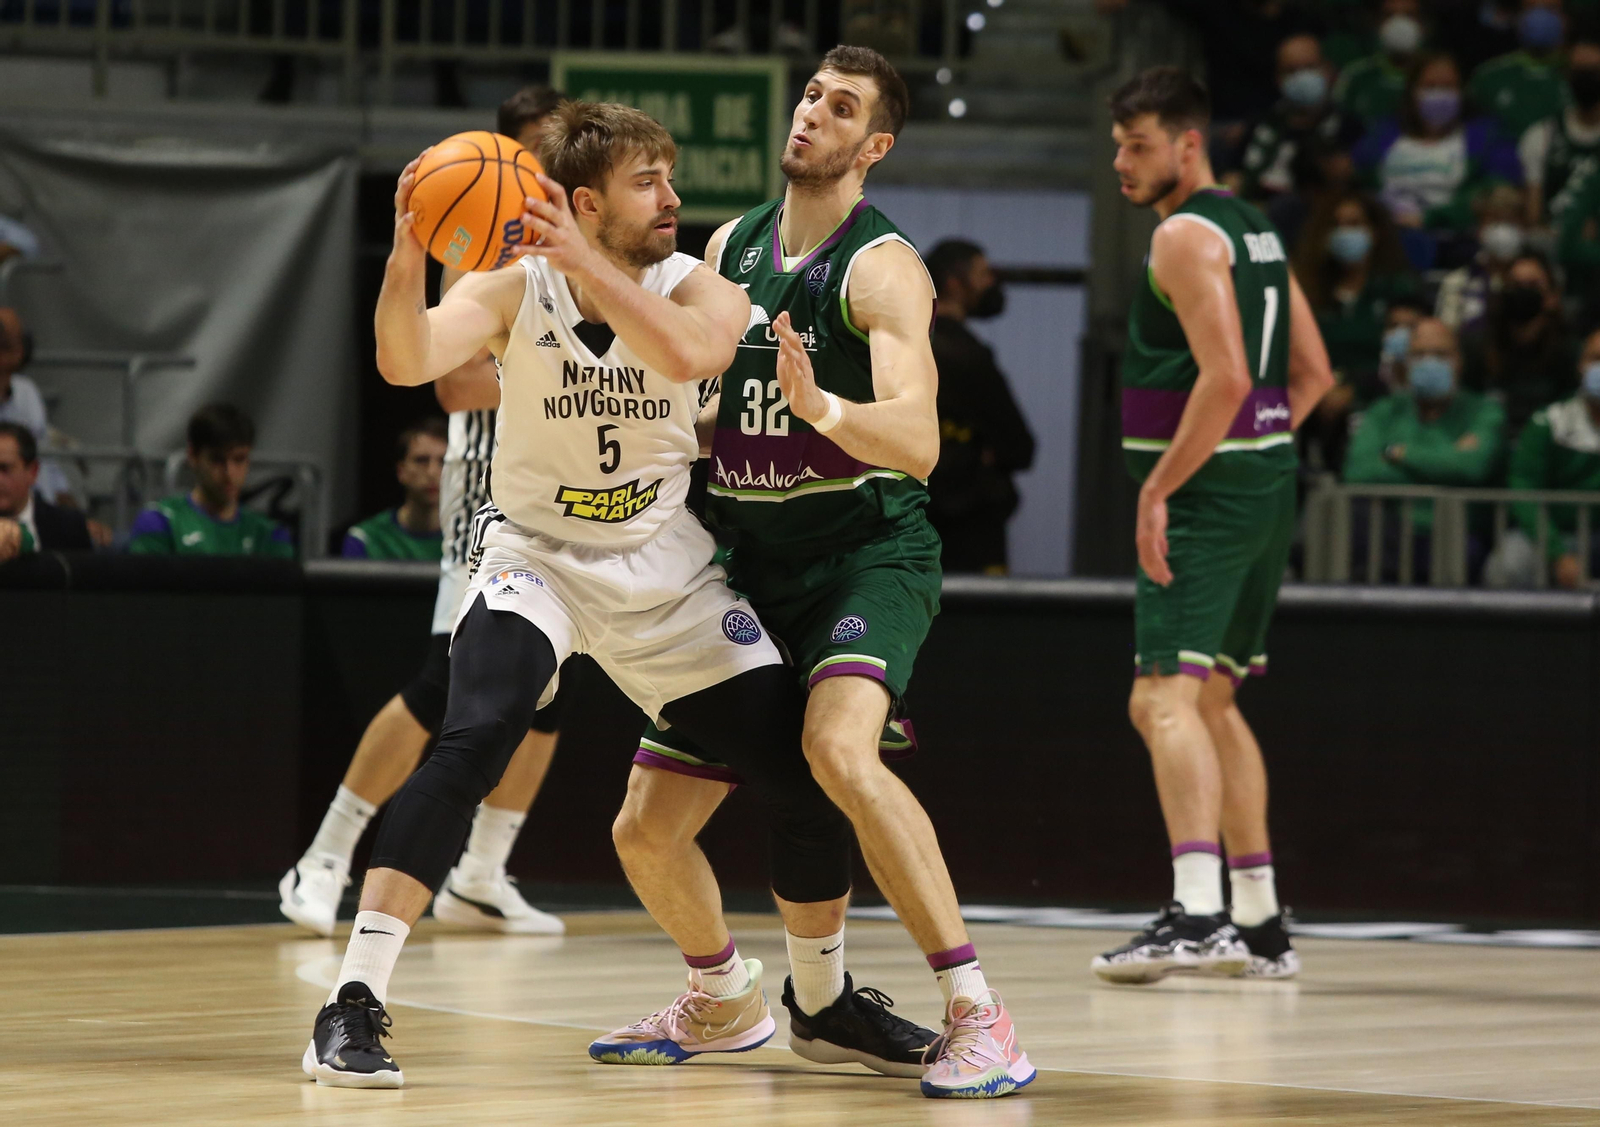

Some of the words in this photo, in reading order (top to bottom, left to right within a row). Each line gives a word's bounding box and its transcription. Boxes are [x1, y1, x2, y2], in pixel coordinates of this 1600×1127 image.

[535, 340, 561, 349] adidas
[1258, 285, 1279, 380] 1
[543, 388, 671, 421] NOVGOROD
[740, 378, 789, 437] 32
[596, 423, 621, 475] 5
[560, 484, 633, 506] PARI
[571, 484, 657, 521] MATCH
[512, 572, 544, 588] PSB
